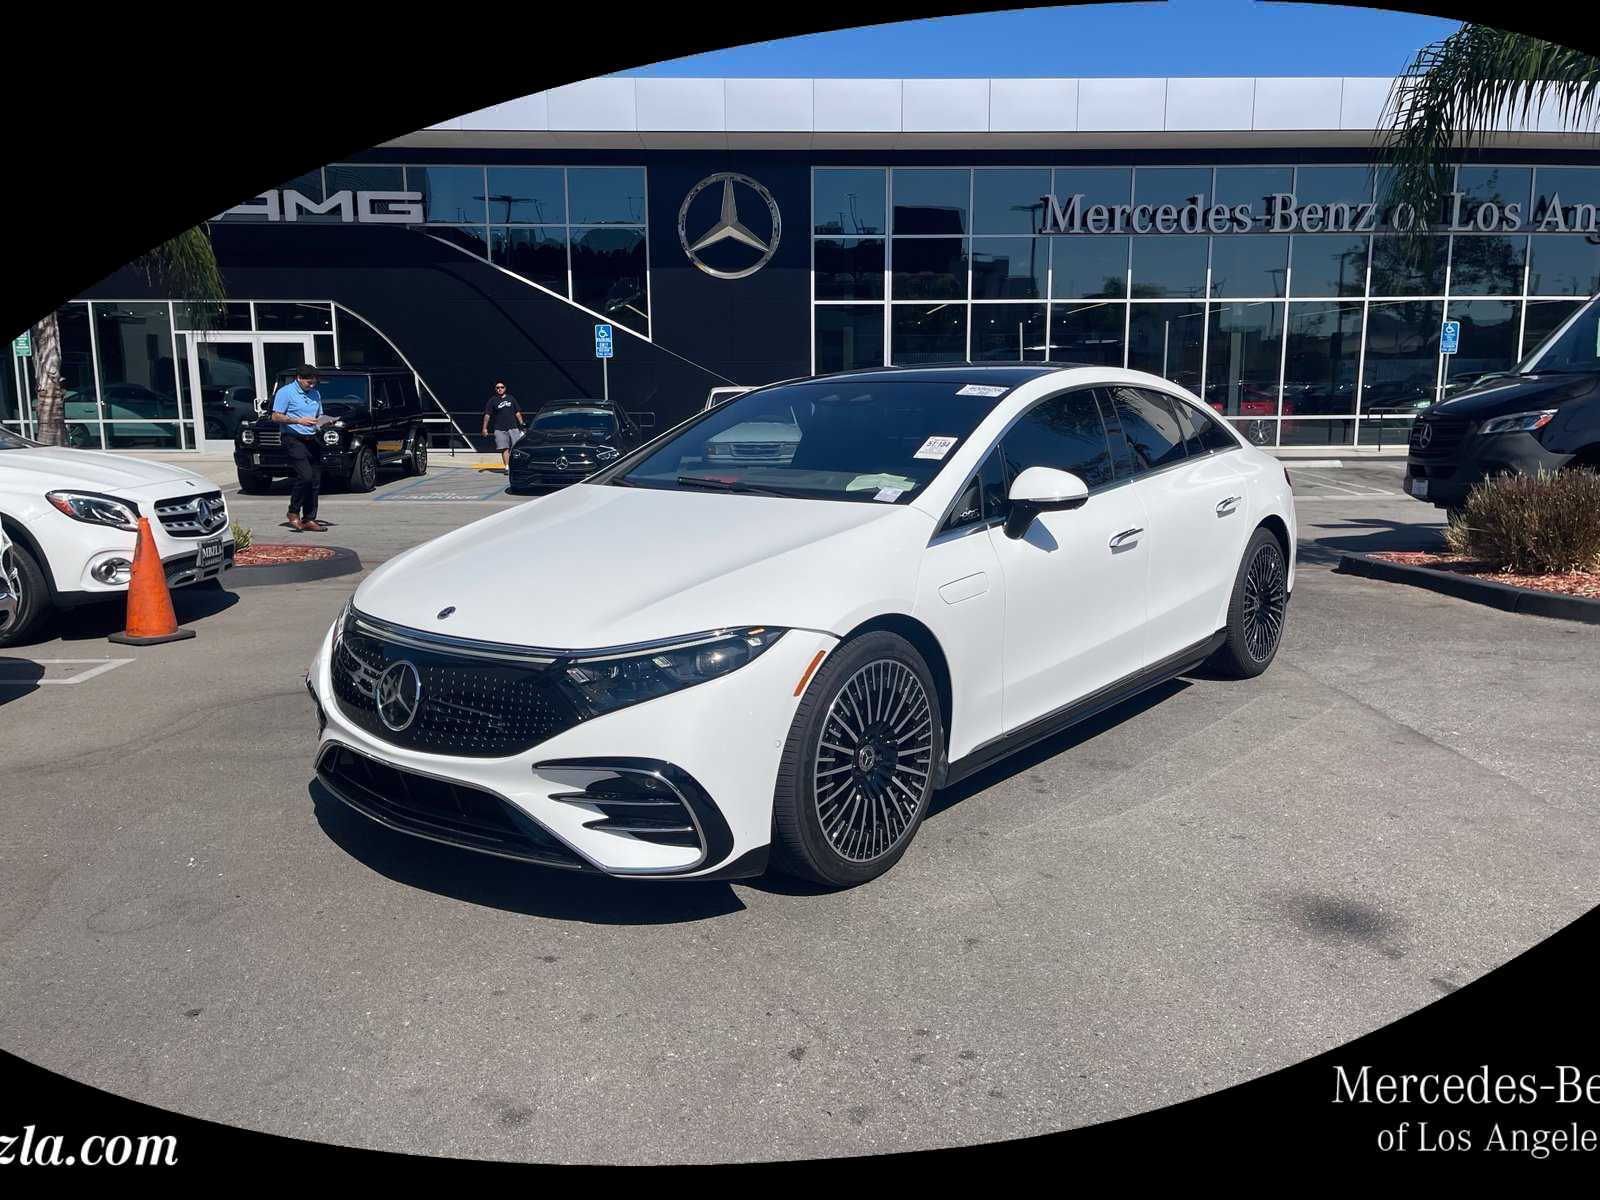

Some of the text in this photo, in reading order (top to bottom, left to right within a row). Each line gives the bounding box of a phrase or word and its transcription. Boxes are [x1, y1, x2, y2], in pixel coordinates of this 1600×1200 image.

[207, 189, 424, 223] AMG
[1042, 193, 1378, 234] Mercedes-Benz
[1449, 192, 1521, 232] Los
